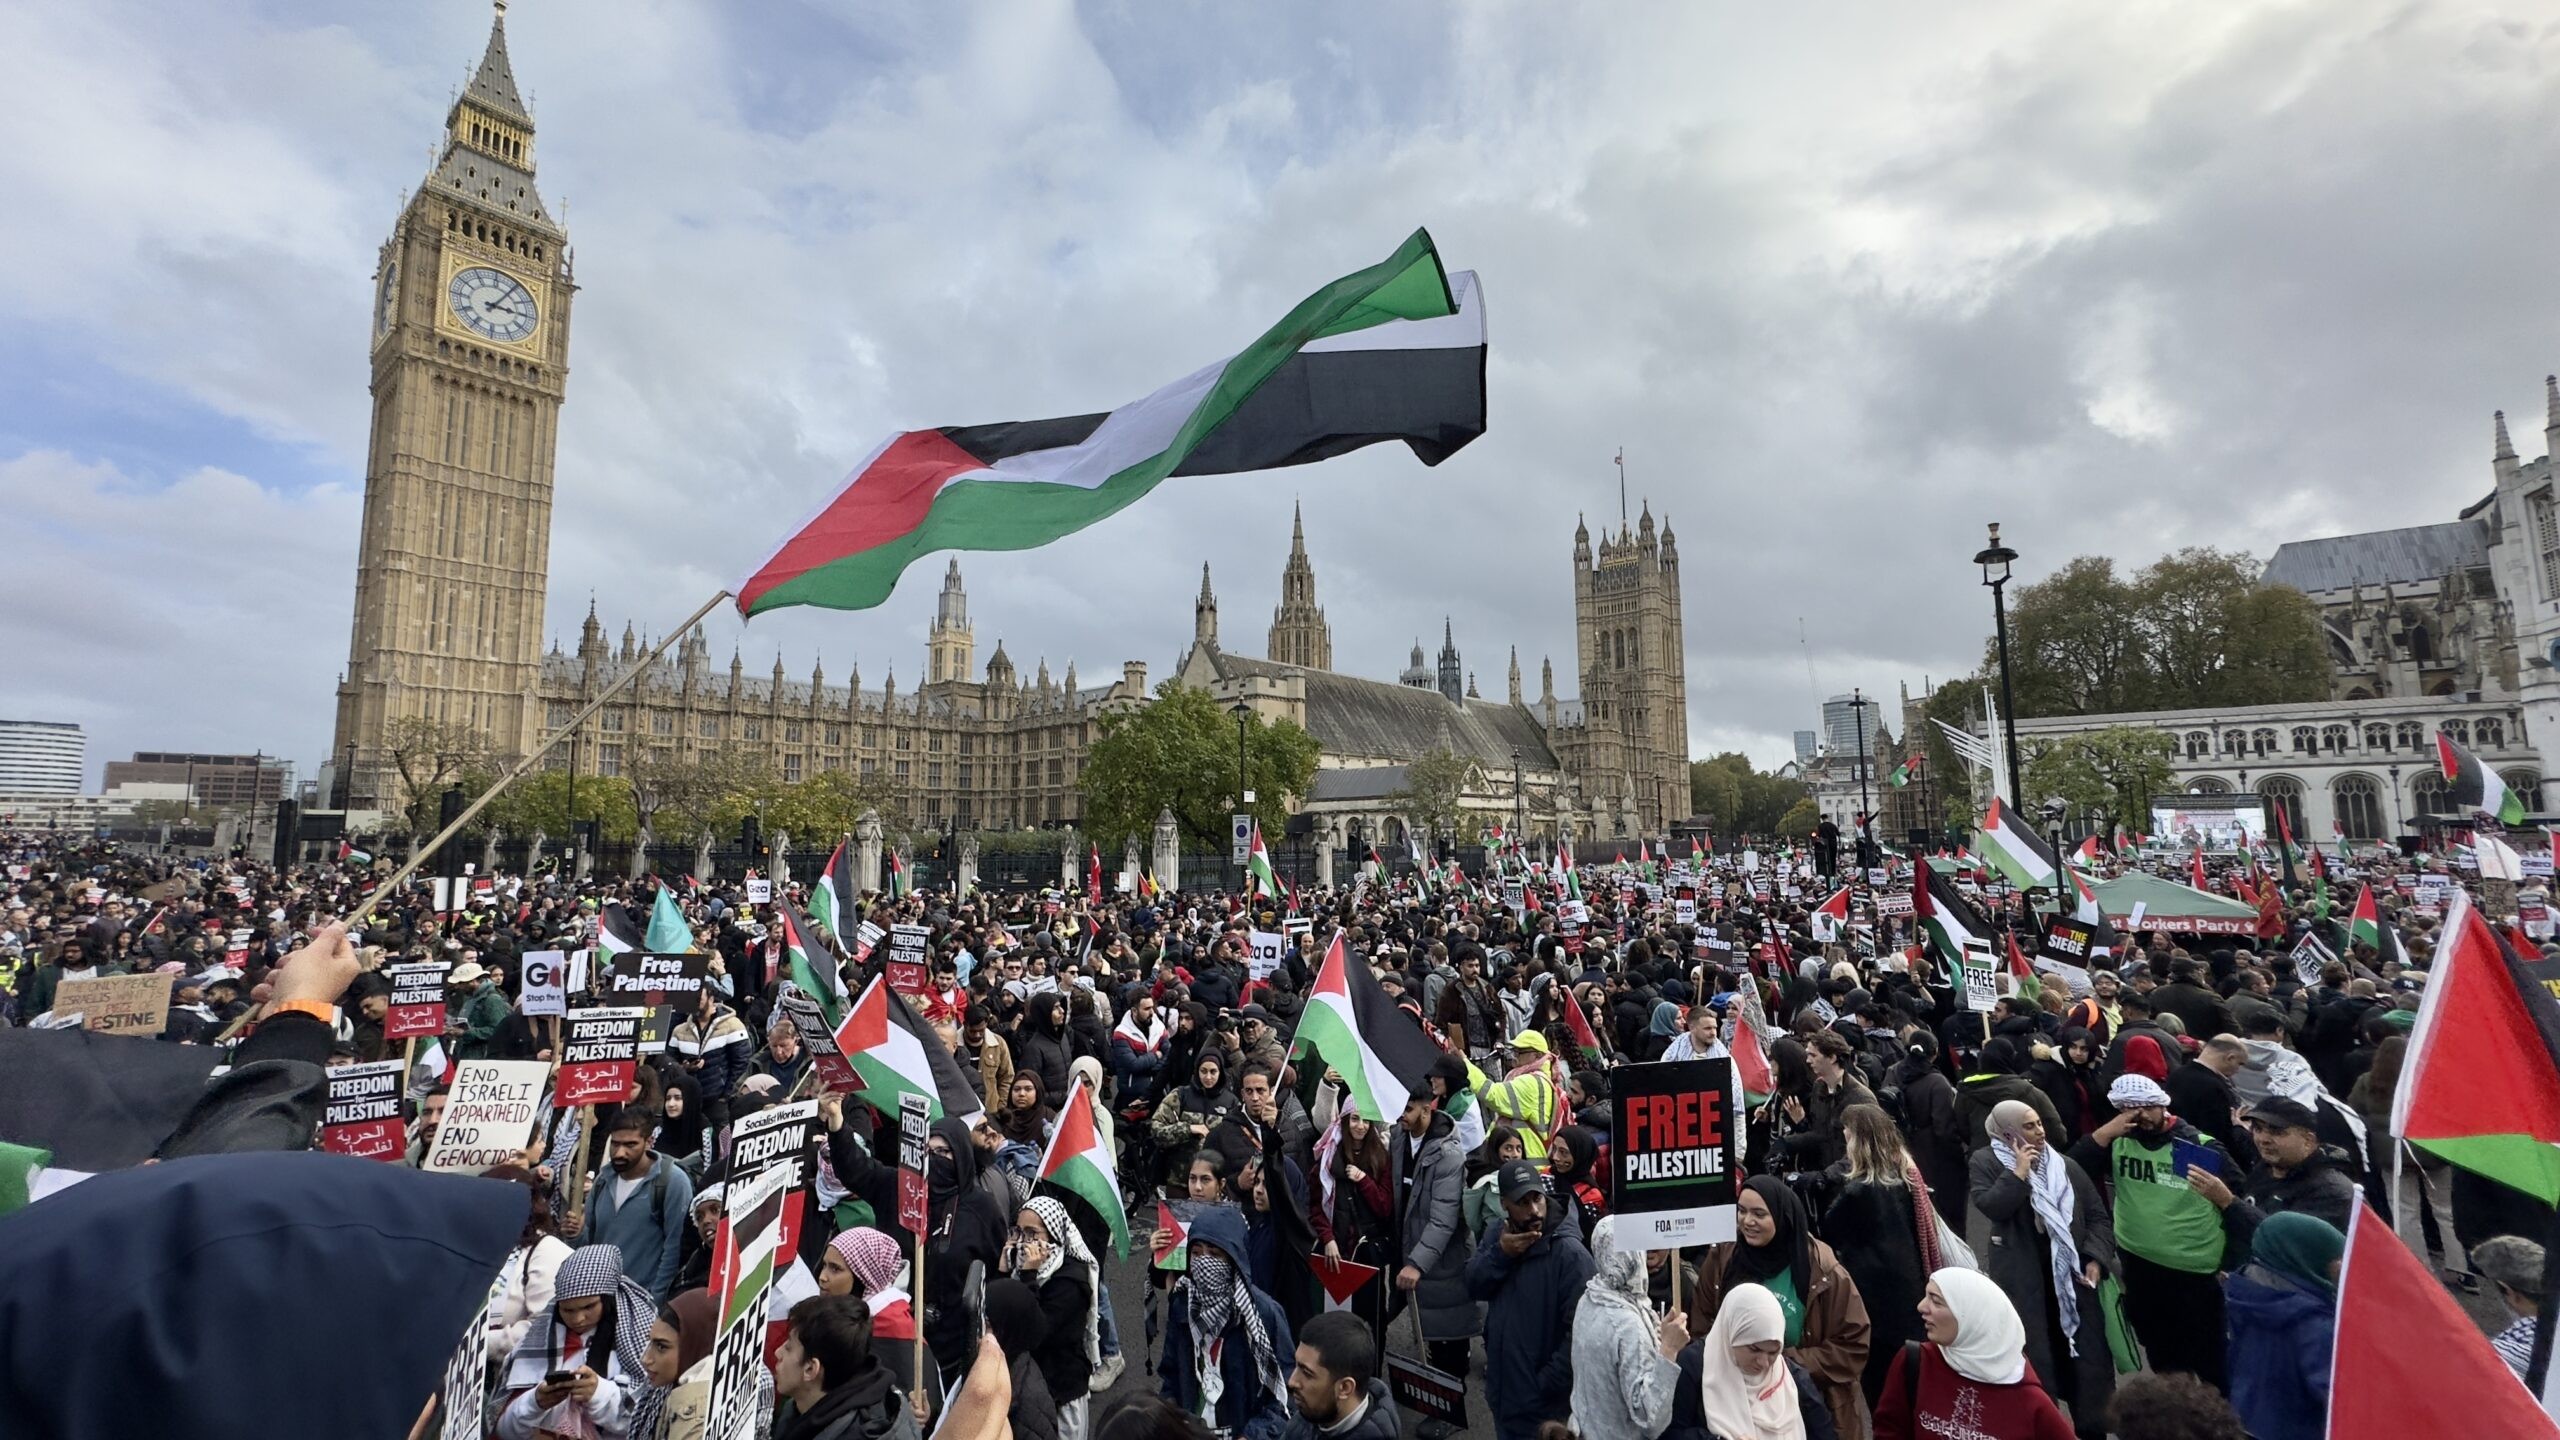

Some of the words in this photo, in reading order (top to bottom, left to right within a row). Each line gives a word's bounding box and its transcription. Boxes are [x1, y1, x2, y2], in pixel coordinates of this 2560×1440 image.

[1888, 905, 1913, 914] GAZA
[2142, 918, 2191, 931] orkers
[2196, 919, 2239, 932] Party
[892, 933, 926, 947] FREEDOM
[2047, 934, 2085, 956] SIEGE
[2070, 929, 2088, 944] THE
[640, 956, 683, 974] Free
[889, 950, 925, 964] PALESTINE
[395, 972, 443, 987] FREEDOM
[613, 974, 701, 991] Palestine
[1966, 968, 1995, 988] FREE
[391, 989, 444, 1004] PALESTINE
[526, 994, 542, 1002] Stop
[572, 1020, 634, 1038] FREEDOM
[566, 1043, 634, 1062] PALESTINE
[334, 1066, 363, 1077] Socialist
[365, 1065, 391, 1073] Worker
[460, 1067, 499, 1083] END
[574, 1065, 619, 1082] الحرية
[329, 1075, 394, 1098] FREEDOM
[454, 1083, 533, 1103] ISRAELI
[565, 1080, 622, 1099] لفلسطين
[354, 1094, 366, 1103] for
[326, 1099, 399, 1123] PALESTINE
[446, 1103, 531, 1125] APPARTHEID
[744, 1113, 776, 1131] Socialist
[776, 1107, 805, 1121] Worker
[902, 1111, 924, 1138] FREED
[1626, 1090, 1722, 1152] FREE
[337, 1125, 384, 1145] الحرية
[441, 1127, 480, 1146] END
[734, 1123, 806, 1168] FREEDOM
[761, 1159, 773, 1172] for
[900, 1142, 922, 1171] PALES
[1626, 1147, 1724, 1181] PALESTINE
[2119, 1155, 2157, 1184] FOA
[1655, 1219, 1672, 1232] FOA
[707, 1284, 769, 1427] FREE
[1403, 1382, 1451, 1412] ISRAELI
